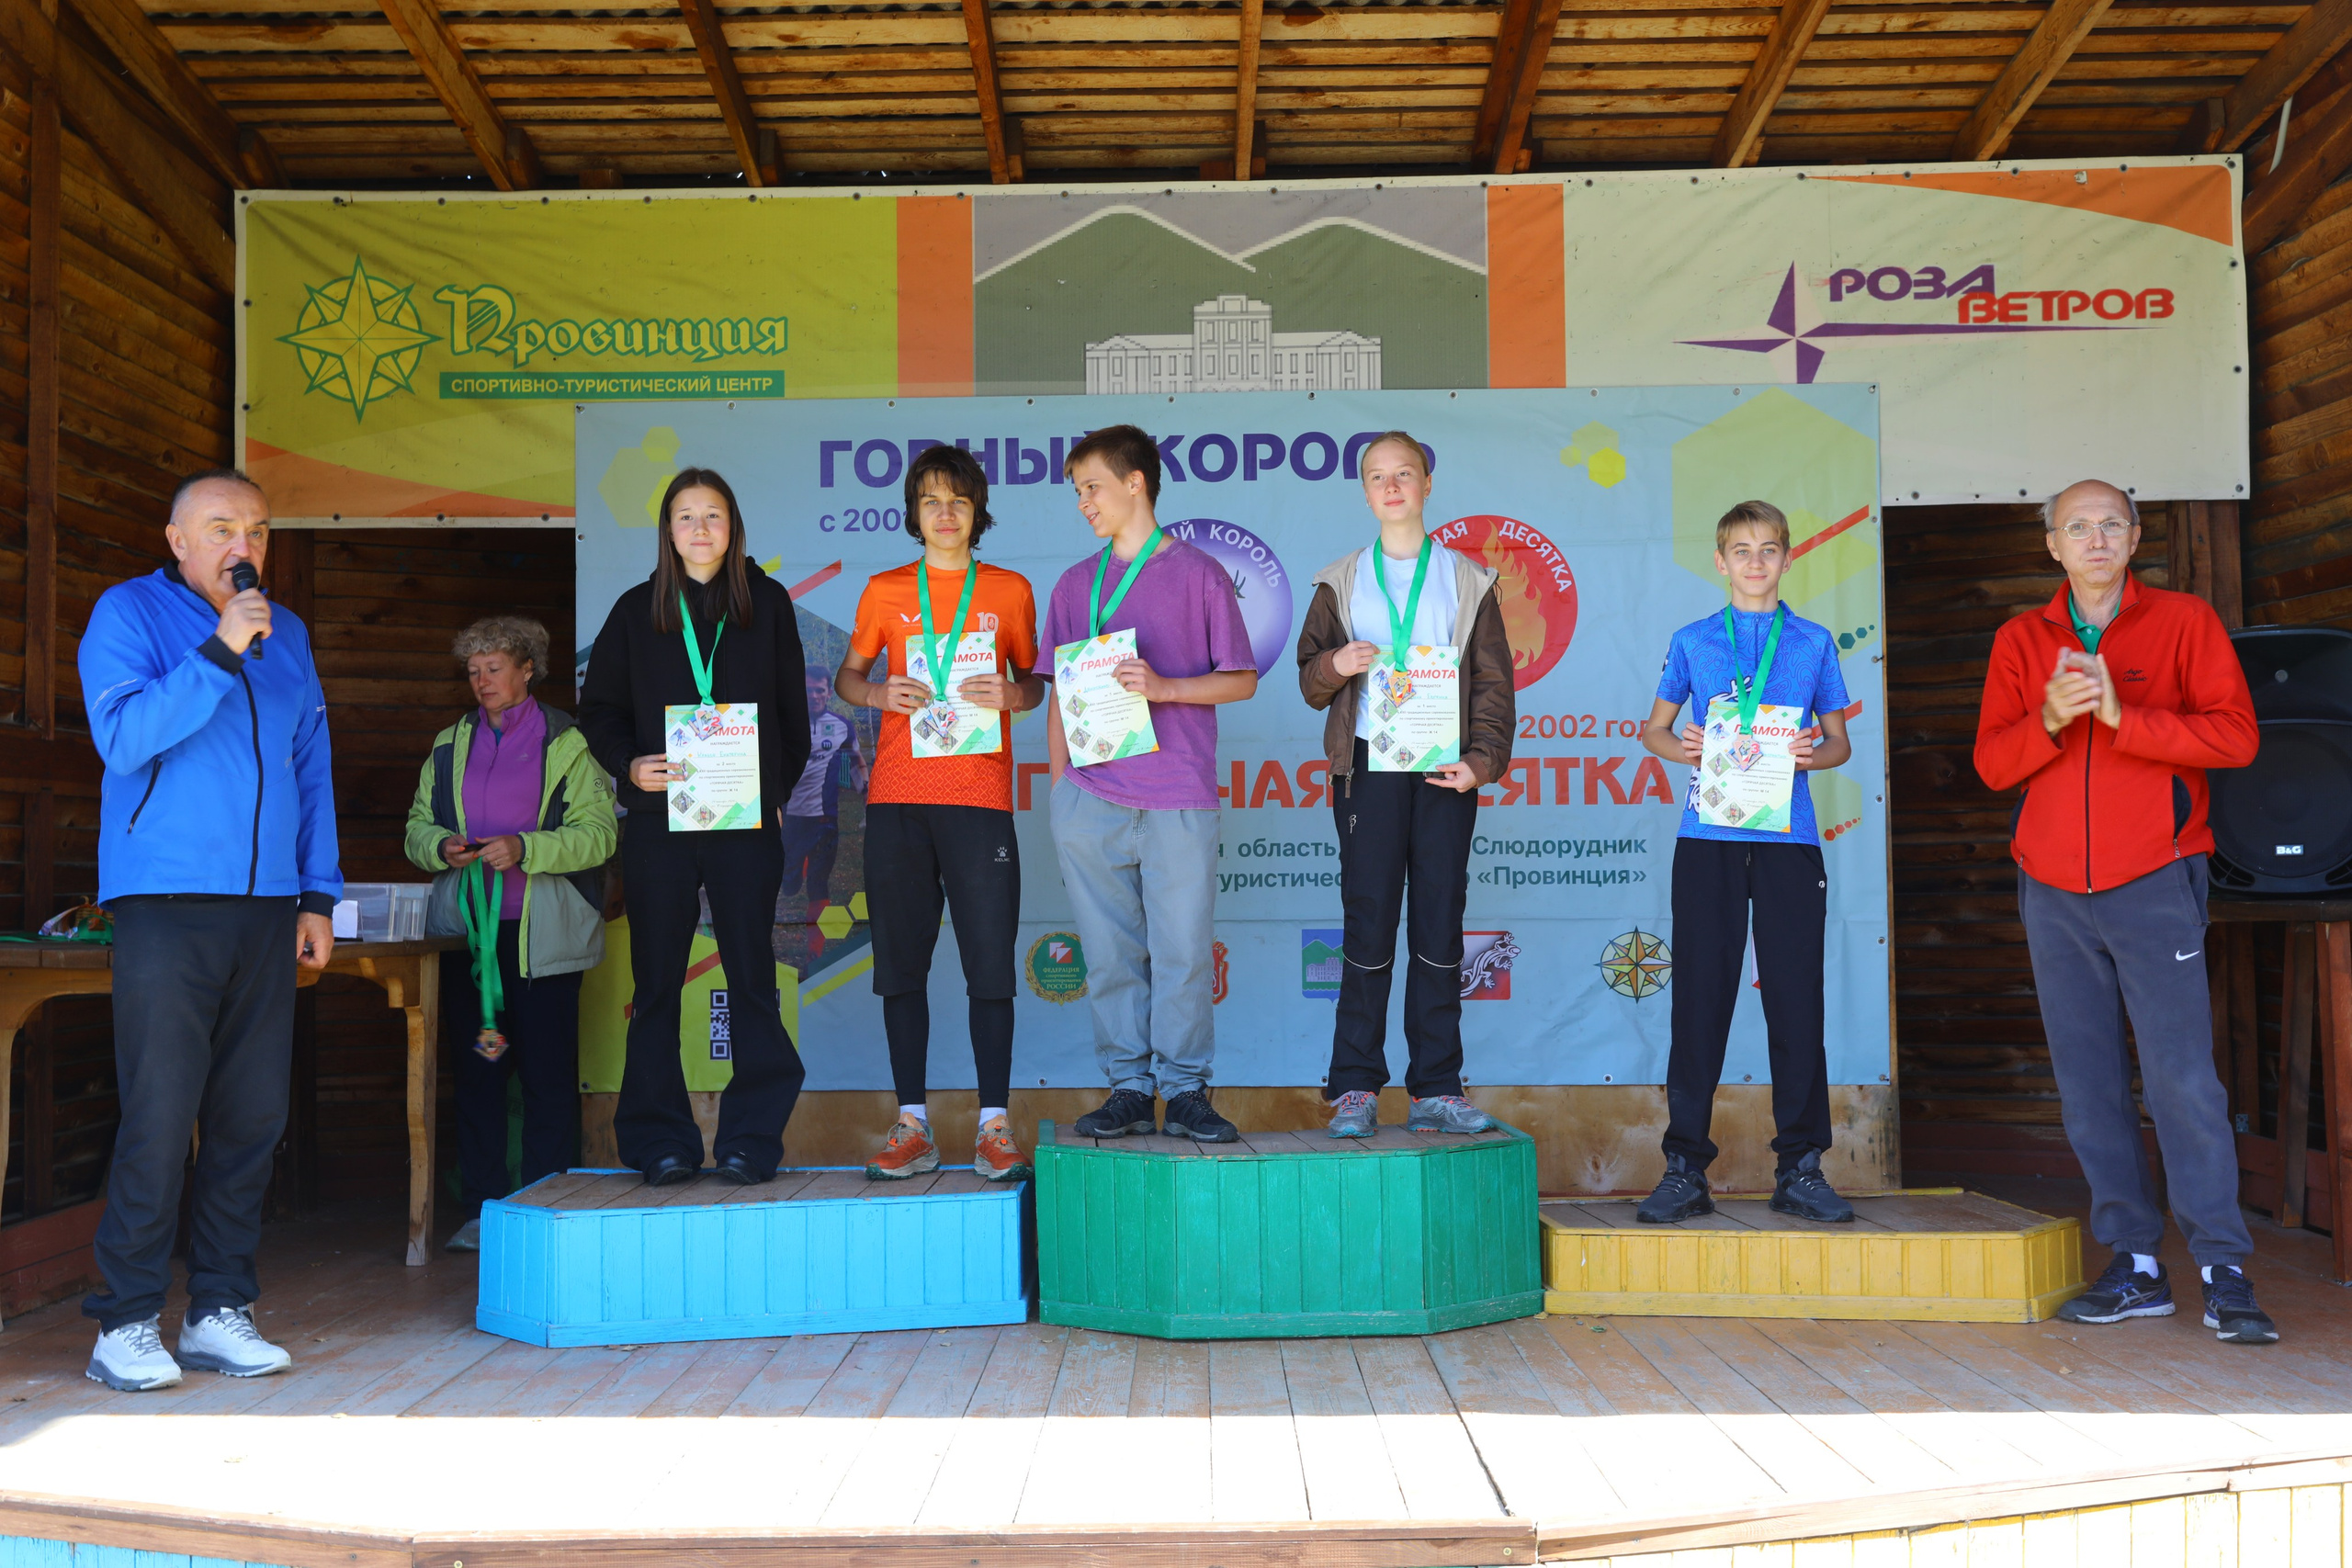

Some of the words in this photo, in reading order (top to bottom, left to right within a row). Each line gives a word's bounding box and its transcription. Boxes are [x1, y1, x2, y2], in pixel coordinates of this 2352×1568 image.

[1829, 265, 1995, 302] РОЗА
[1958, 288, 2175, 324] ВЕТРОВ
[434, 283, 788, 368] Провинция
[450, 376, 711, 394] СПОРТИВНО-ТУРИСТИЧЕСКИЙ
[716, 375, 773, 393] ЦЕНТР
[843, 507, 907, 532] 200
[1209, 524, 1283, 588] КОРОЛЬ
[1498, 520, 1572, 592] ДЕСЯТКА
[1519, 715, 1598, 739] 2002
[1751, 743, 1759, 753] 3
[1472, 836, 1647, 858] Слюдорудник
[2276, 845, 2302, 855] B&G
[1477, 866, 1647, 888] «Провинция»
